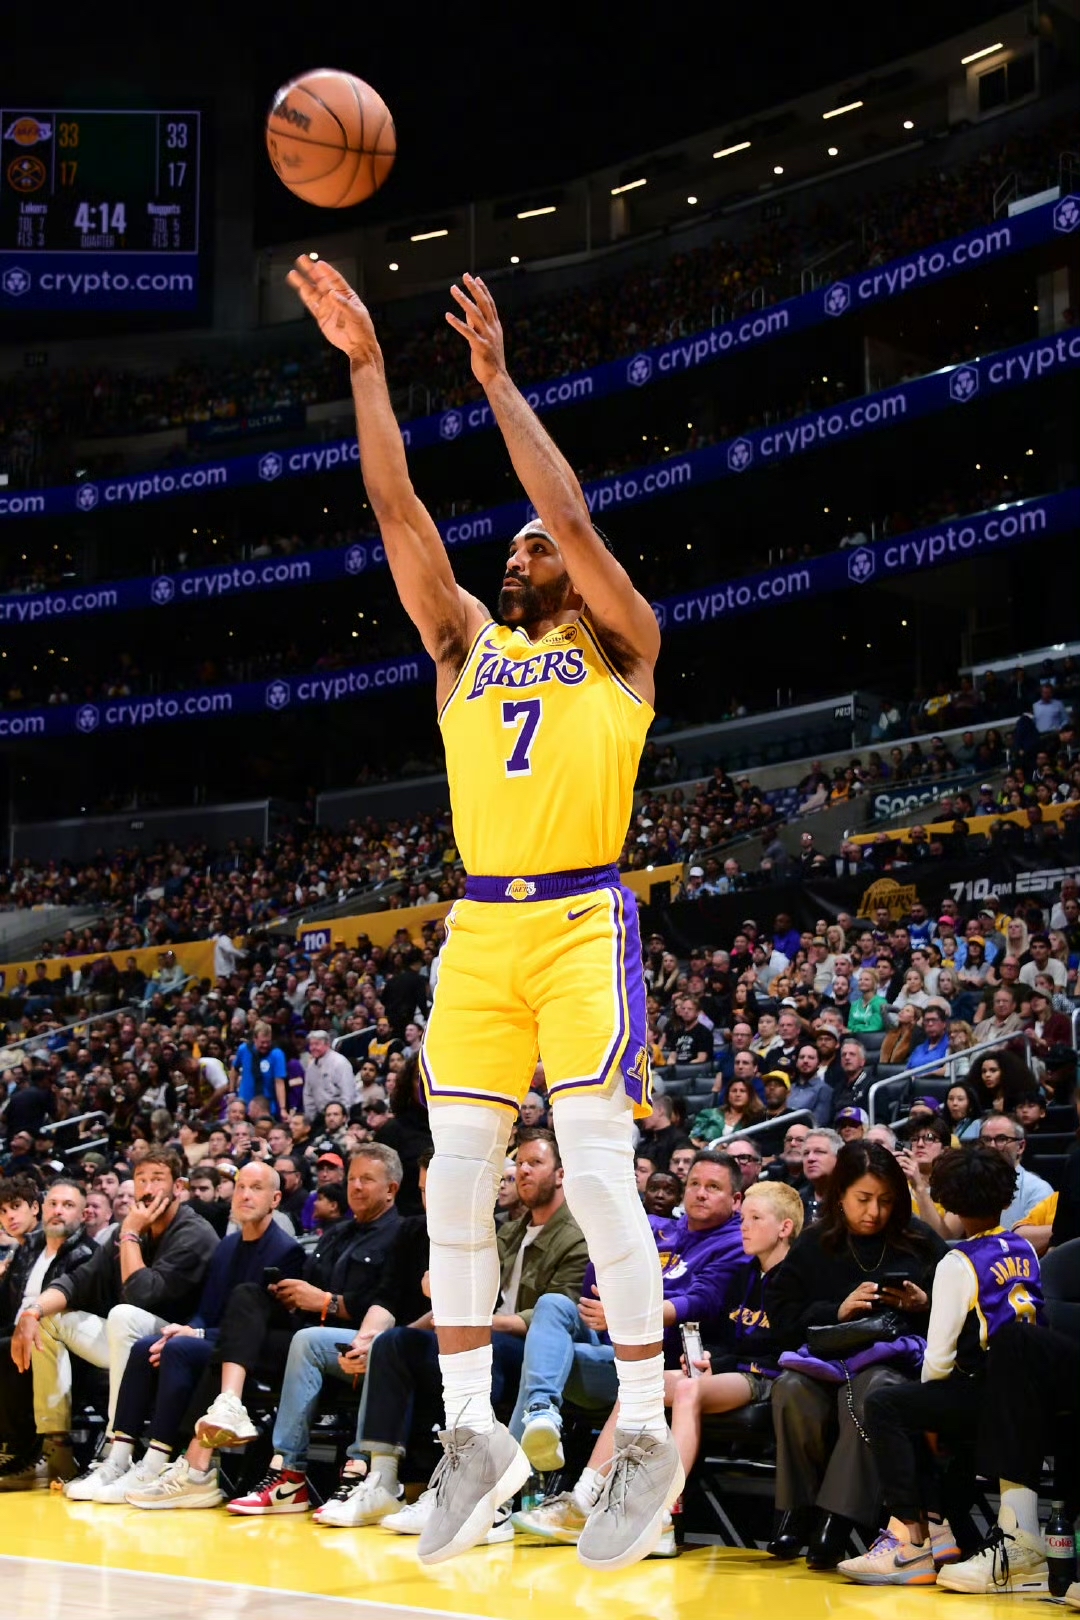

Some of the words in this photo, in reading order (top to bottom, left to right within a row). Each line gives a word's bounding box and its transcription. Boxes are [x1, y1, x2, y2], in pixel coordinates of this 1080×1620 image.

[58, 123, 79, 147] 33
[167, 123, 188, 148] 33
[60, 161, 78, 186] 17
[168, 162, 187, 187] 17
[74, 202, 127, 234] 4:14
[858, 227, 1011, 299] crypto.com
[39, 271, 193, 294] crypto.com
[658, 309, 789, 371] crypto.com
[760, 394, 906, 456] crypto.com
[104, 467, 227, 501] crypto.com
[584, 463, 691, 513] ypto.com
[884, 505, 1046, 567] crypto.com
[181, 561, 311, 595] crypto.com
[673, 570, 810, 622] crypto.com
[297, 662, 418, 700] crypto.com
[465, 648, 588, 702] LAKERS
[105, 693, 232, 724] crypto.com
[501, 697, 543, 779] 7
[949, 878, 989, 902] 710
[303, 931, 327, 950] 110
[989, 1256, 1031, 1286] JAMES
[1048, 1536, 1073, 1548] Coke
